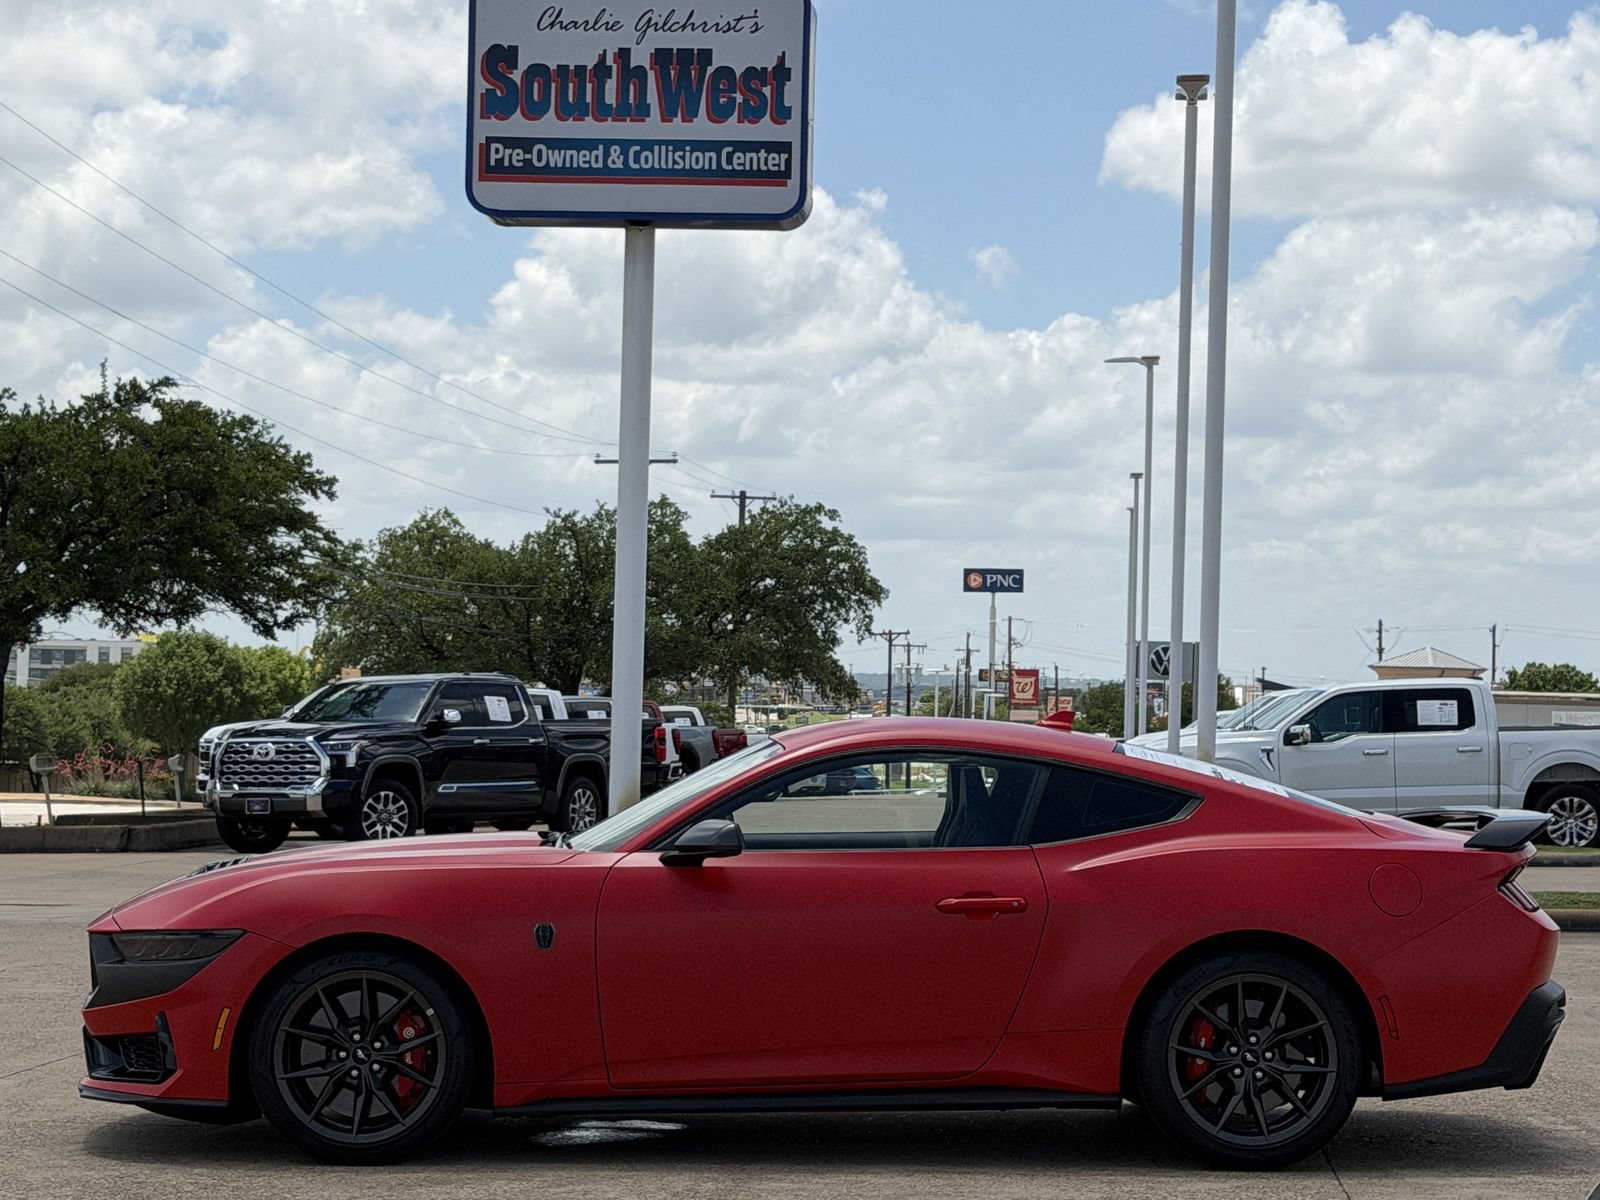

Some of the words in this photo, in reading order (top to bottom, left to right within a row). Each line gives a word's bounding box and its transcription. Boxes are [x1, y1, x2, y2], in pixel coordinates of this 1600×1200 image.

[536, 6, 624, 32] Charlie
[633, 8, 764, 45] Gilchrist's
[480, 43, 792, 125] SouthWest
[489, 142, 603, 169] Pre-Owned
[607, 146, 624, 169] &
[628, 145, 718, 172] Collision
[720, 146, 789, 172] Center
[985, 574, 1020, 588] PNC
